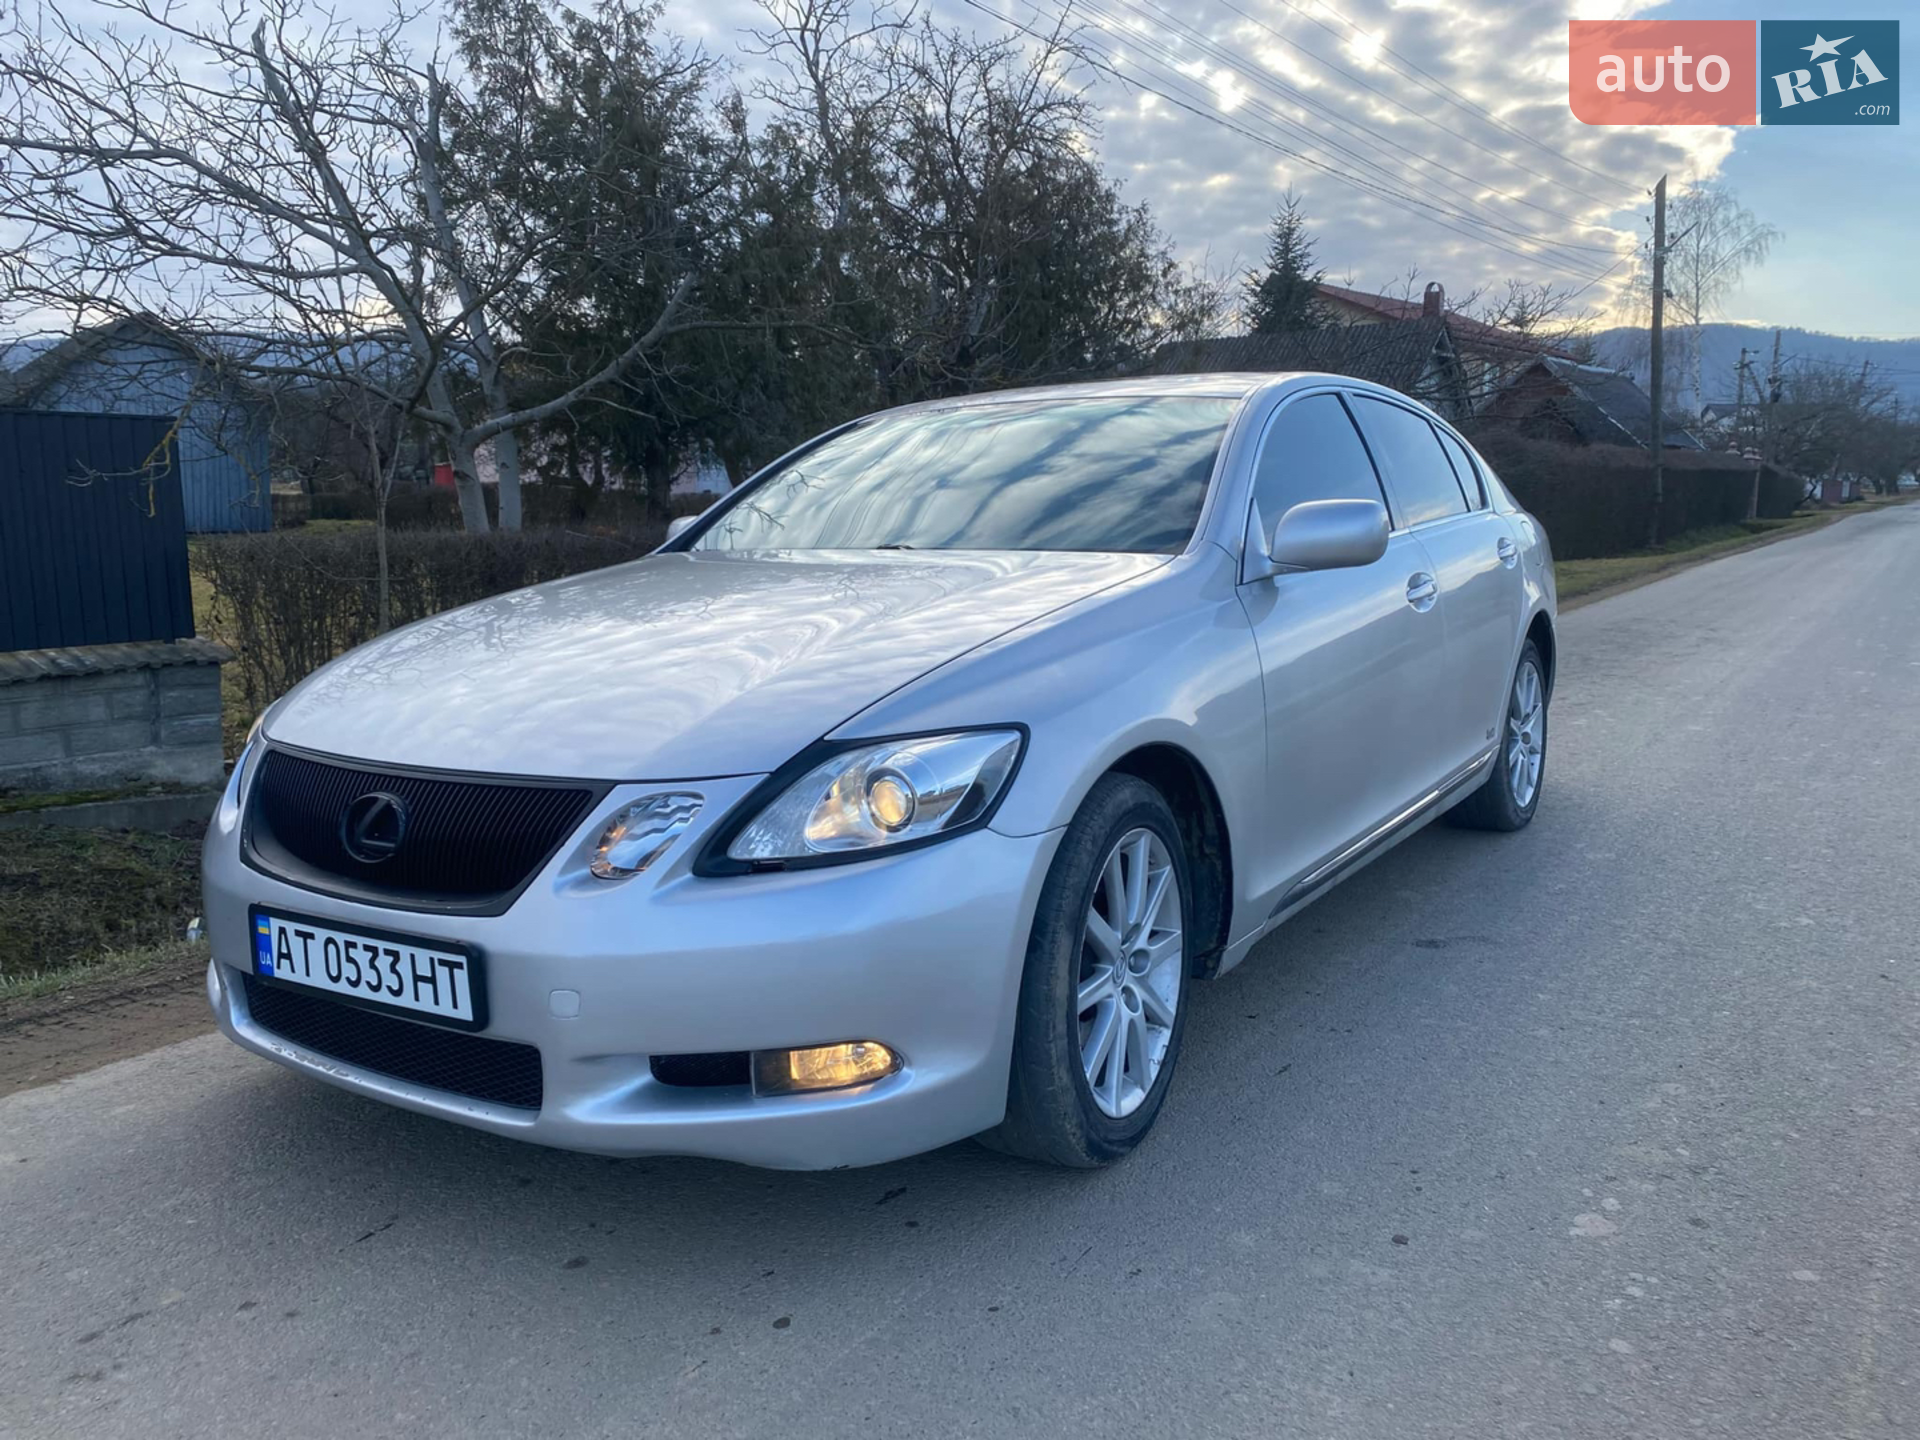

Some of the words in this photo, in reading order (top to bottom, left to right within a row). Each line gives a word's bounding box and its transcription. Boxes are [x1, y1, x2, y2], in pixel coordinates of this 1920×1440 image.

[259, 950, 273, 967] UA
[276, 926, 316, 978] AT
[323, 936, 404, 997] 0533
